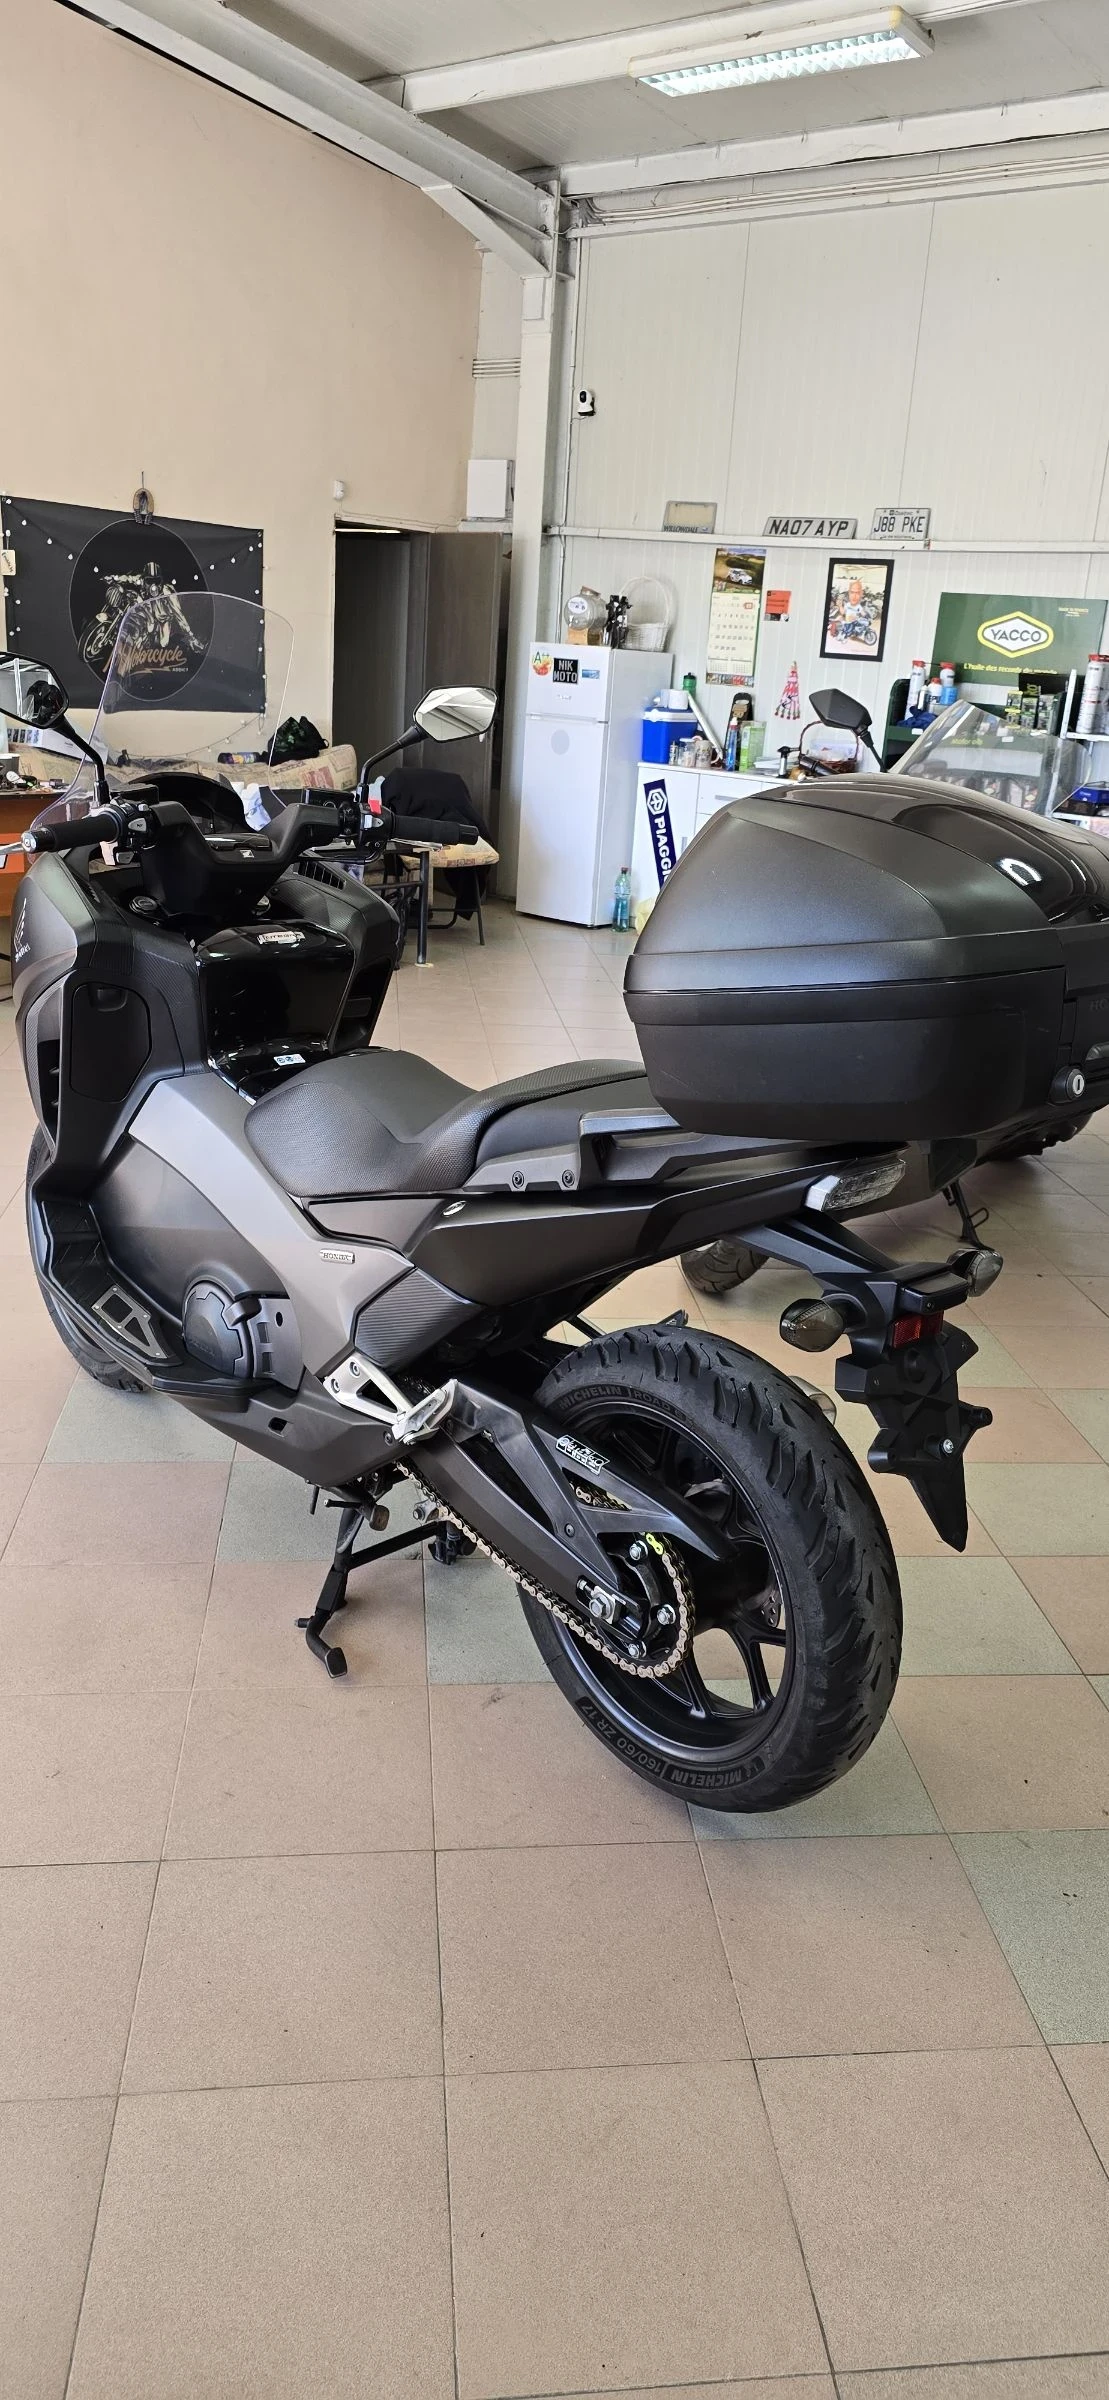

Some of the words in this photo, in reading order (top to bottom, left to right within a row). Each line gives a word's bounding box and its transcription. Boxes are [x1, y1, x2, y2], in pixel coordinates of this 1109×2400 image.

[769, 519, 813, 536] NA07
[814, 520, 849, 537] AYP
[873, 516, 896, 533] J88
[902, 516, 926, 533] PKE
[990, 629, 1042, 643] YACCO
[558, 660, 574, 672] NIK
[553, 670, 578, 683] MOTO
[654, 815, 673, 883] PIAGGI
[560, 1385, 622, 1410] MICHELIN
[634, 1390, 671, 1412] ROAD
[581, 1703, 598, 1721] 17
[596, 1720, 617, 1737] ZR
[616, 1736, 661, 1773] 160/60
[671, 1768, 742, 1787] MICHELIN
